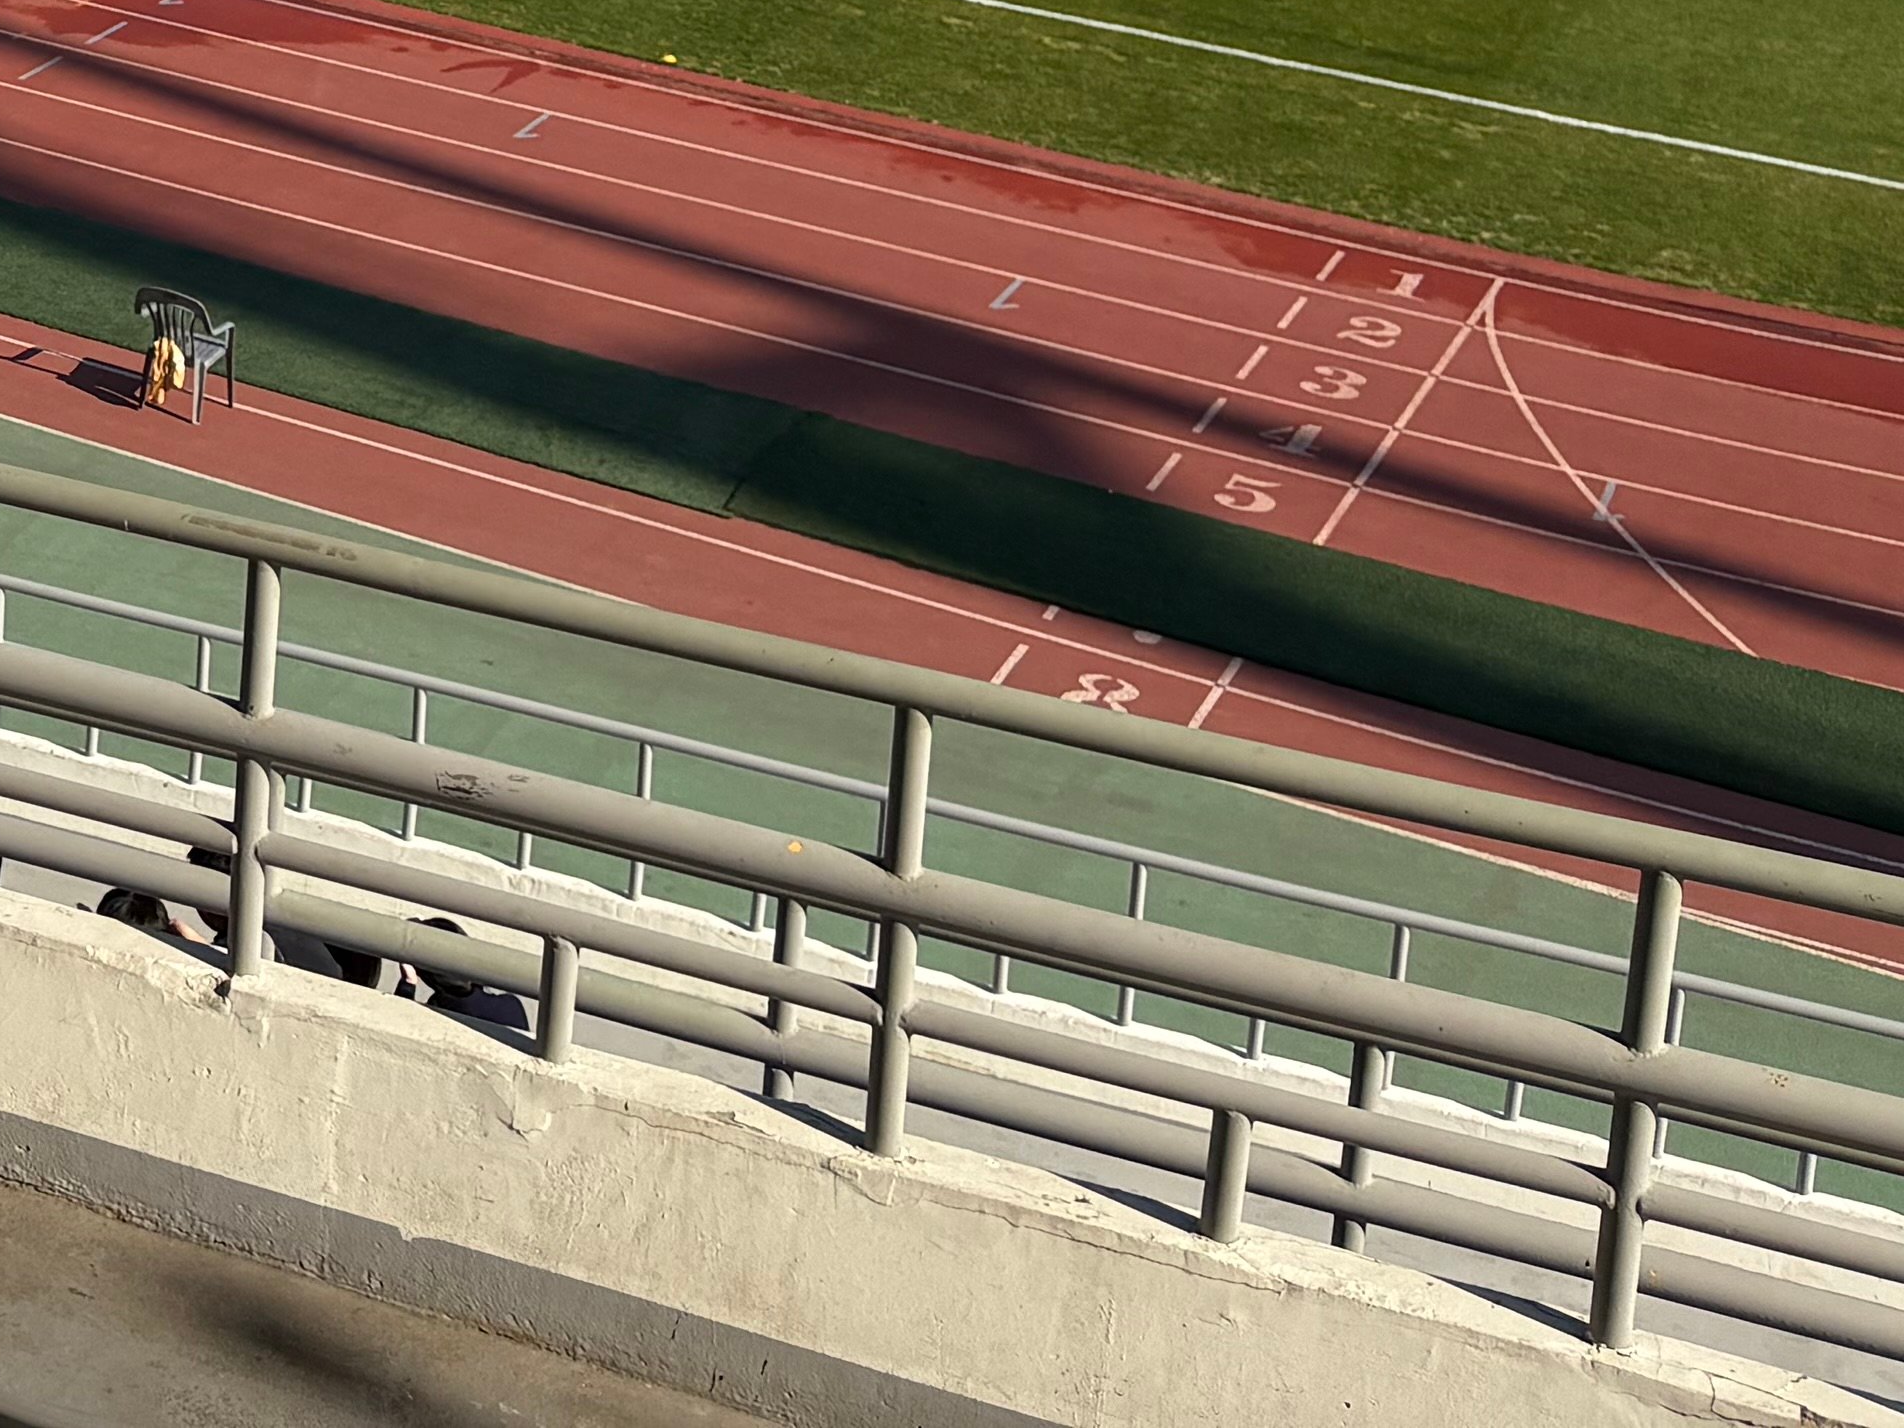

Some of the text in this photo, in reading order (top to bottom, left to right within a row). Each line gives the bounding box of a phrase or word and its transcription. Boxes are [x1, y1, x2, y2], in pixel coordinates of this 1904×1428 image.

[1377, 270, 1425, 301] 1
[1337, 315, 1402, 348] 2
[1299, 365, 1368, 400] 3
[1259, 423, 1323, 458] 4
[1213, 474, 1282, 514] 5
